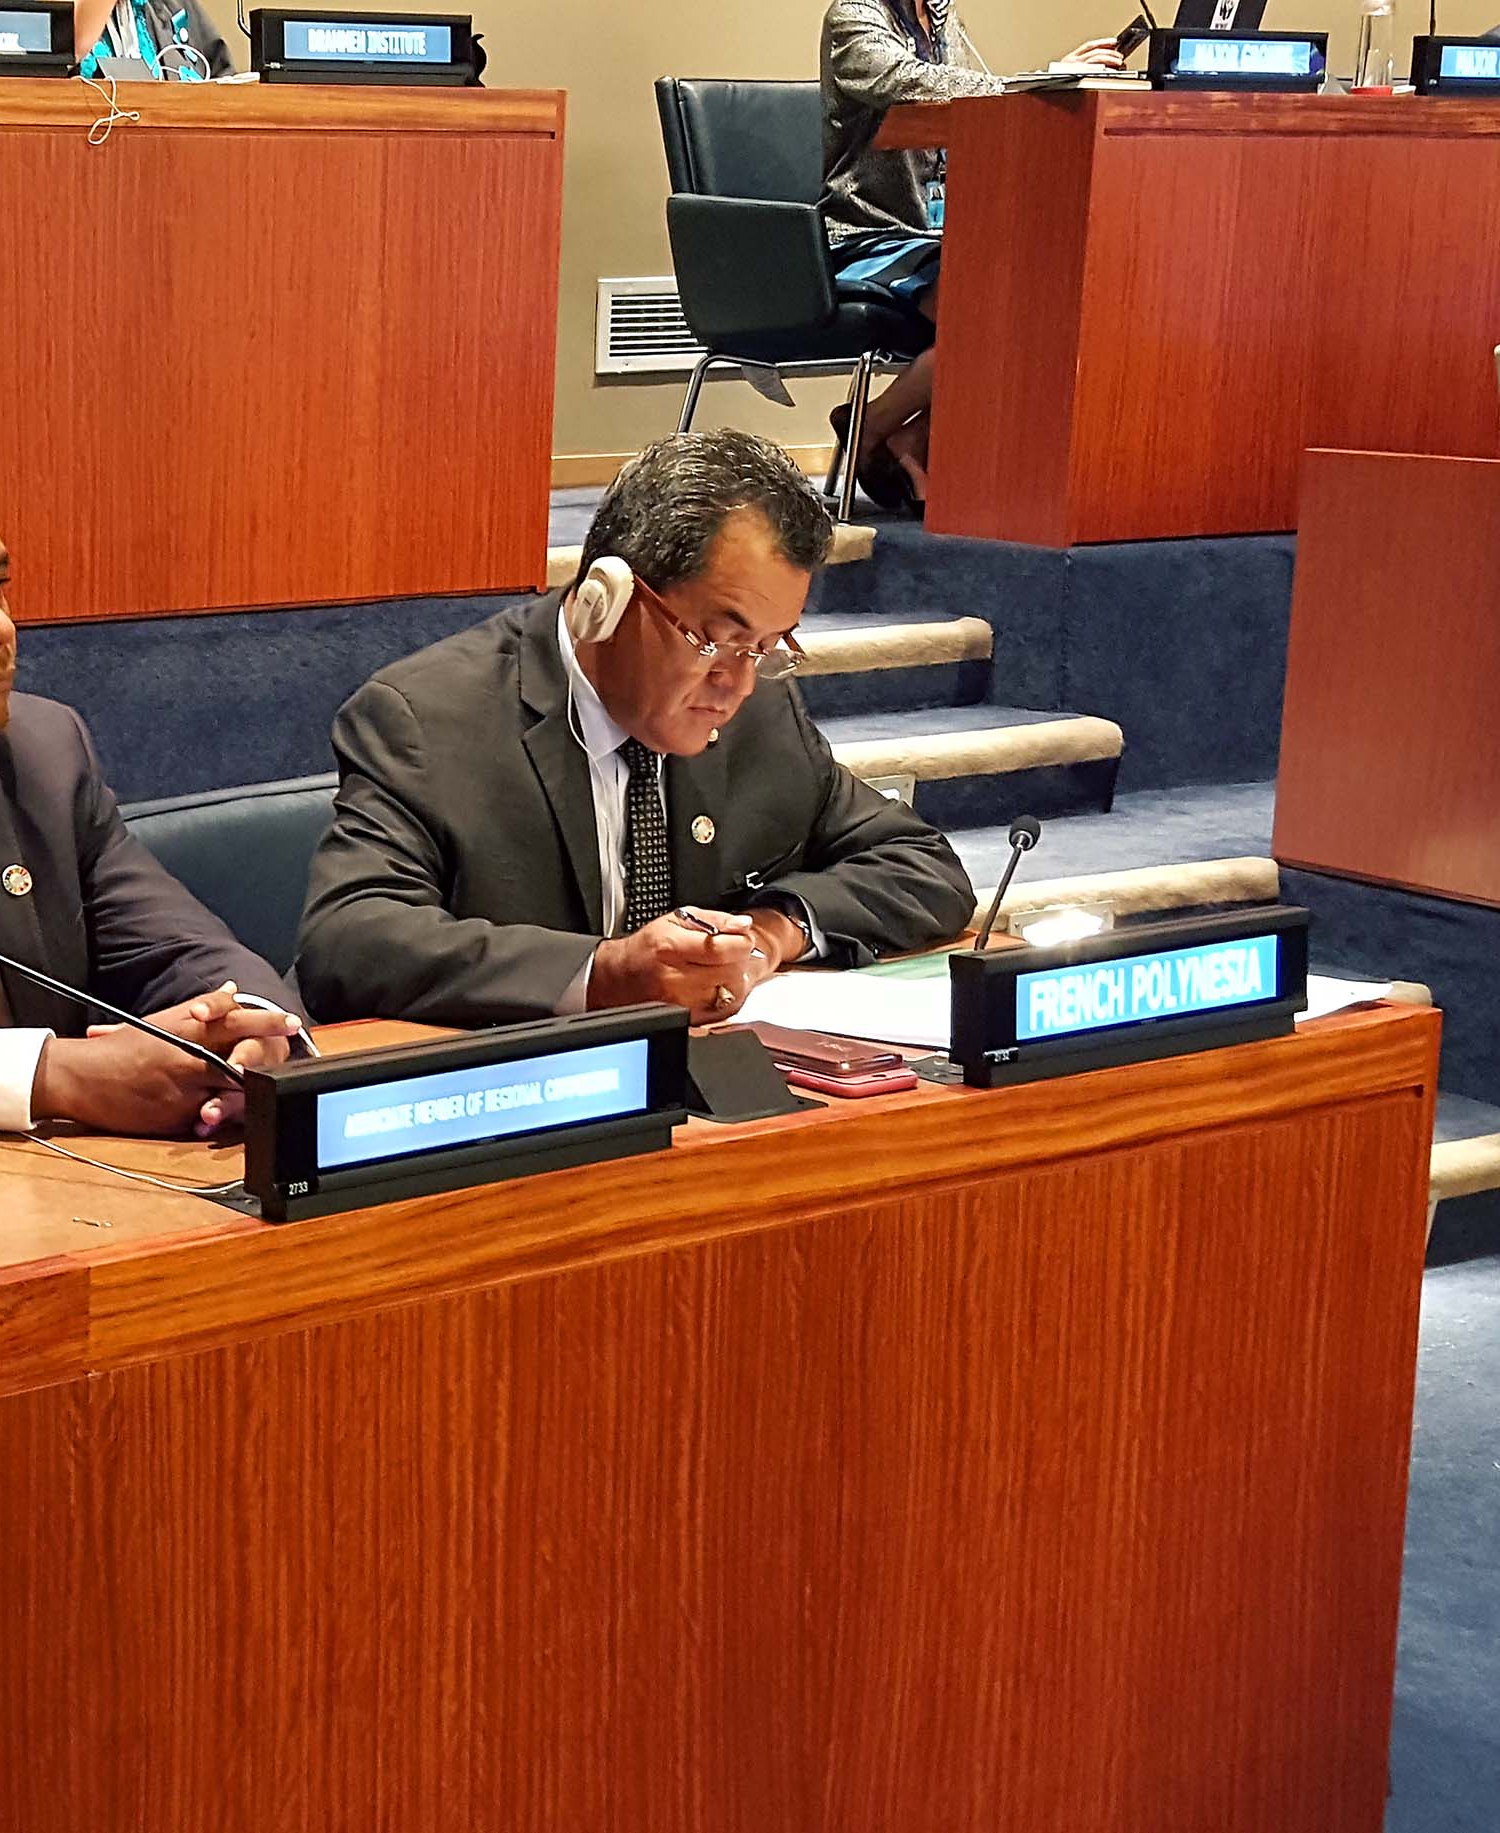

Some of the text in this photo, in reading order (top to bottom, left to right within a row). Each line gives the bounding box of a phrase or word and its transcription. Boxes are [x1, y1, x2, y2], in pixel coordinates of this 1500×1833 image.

[366, 30, 427, 56] INSTITUTE
[1028, 946, 1262, 1032] FRENCH POLYNESIA
[466, 1091, 484, 1116] OF
[288, 1181, 308, 1195] 2733
